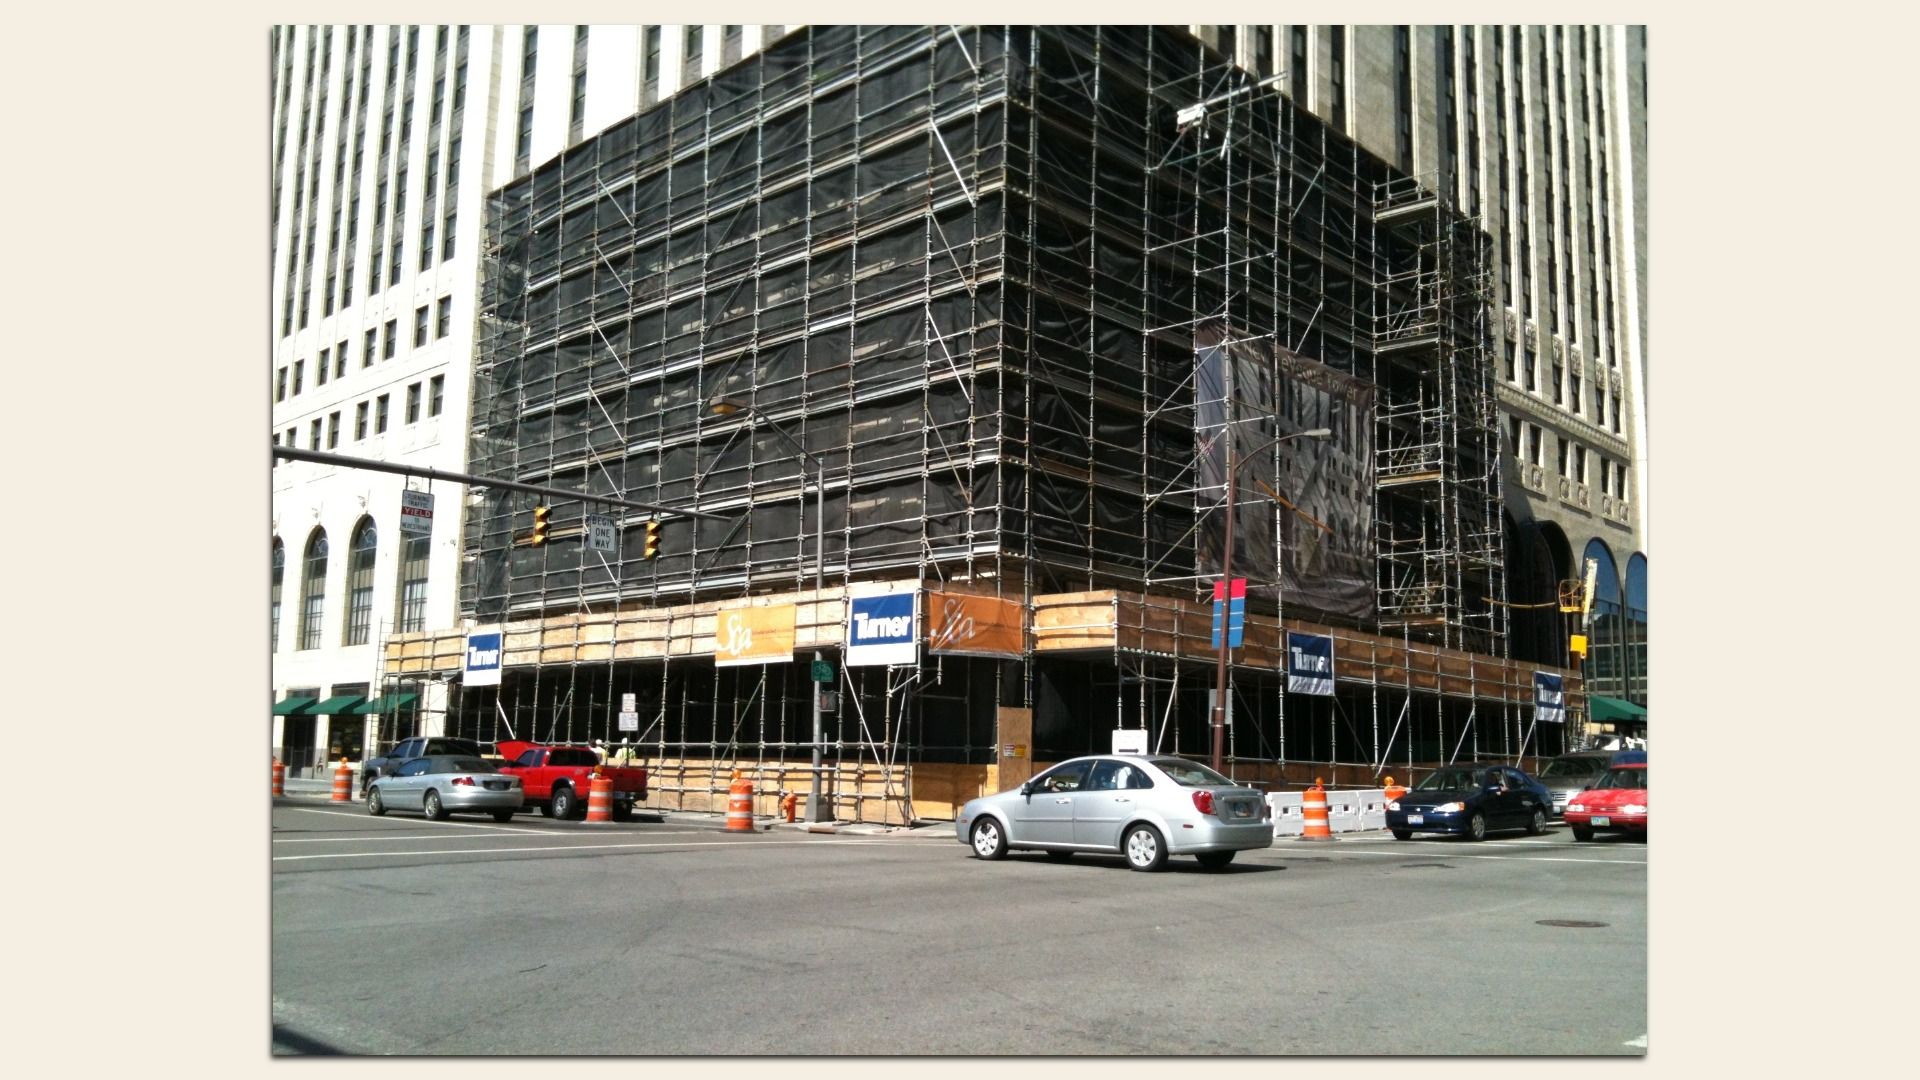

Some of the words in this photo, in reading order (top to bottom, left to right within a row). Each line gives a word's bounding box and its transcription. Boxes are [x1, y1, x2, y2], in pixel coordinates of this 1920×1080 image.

[1326, 371, 1357, 402] Tower
[404, 507, 431, 517] YIELD
[591, 515, 615, 527] BEGIN
[595, 527, 611, 538] ONE
[595, 539, 610, 549] WAY
[854, 612, 911, 640] Turner
[468, 646, 499, 666] Turner
[1291, 646, 1329, 673] Turner
